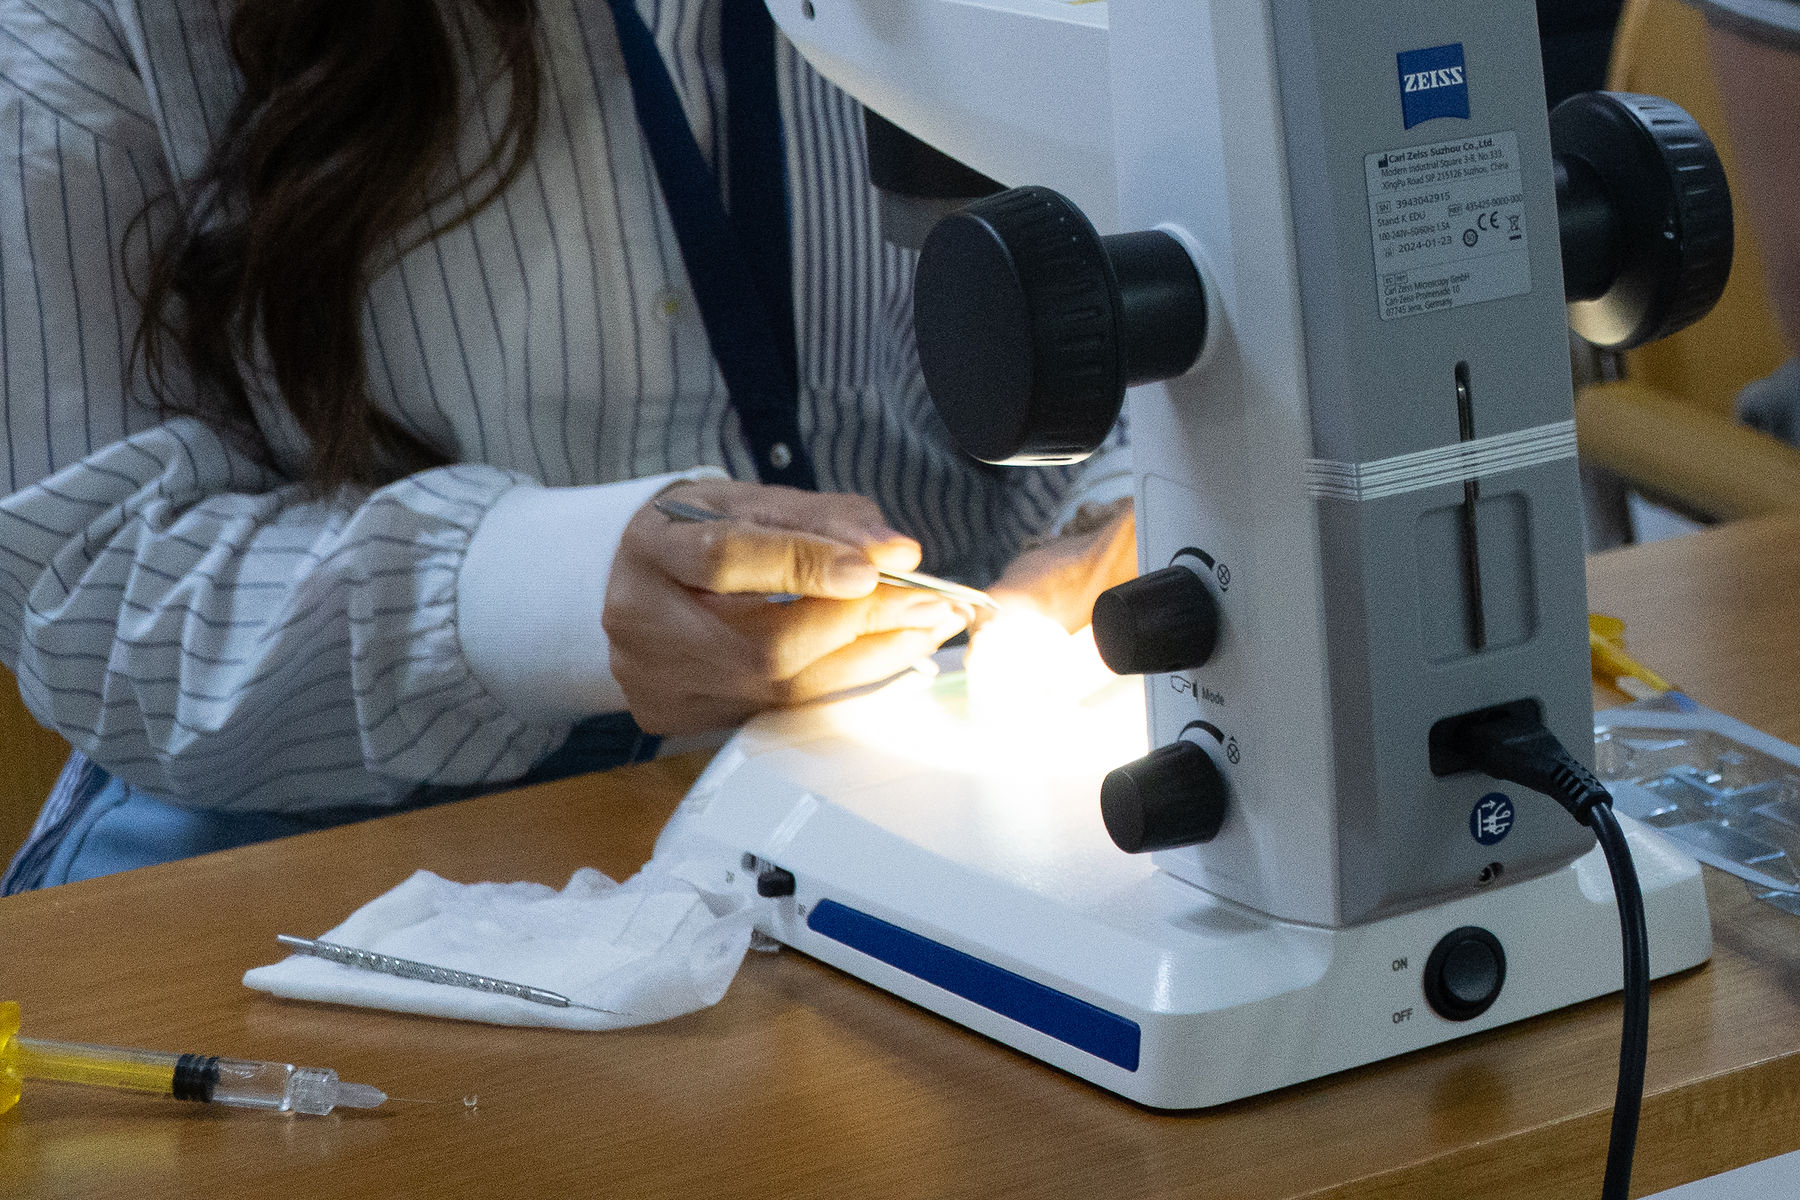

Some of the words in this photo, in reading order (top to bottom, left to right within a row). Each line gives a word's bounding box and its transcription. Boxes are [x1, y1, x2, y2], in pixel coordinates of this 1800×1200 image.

[1404, 66, 1464, 93] ZEISS
[1388, 153, 1406, 164] Carl
[1407, 150, 1428, 161] Zeiss
[1430, 145, 1461, 157] Suzhou
[1409, 211, 1426, 222] EDU
[1398, 236, 1452, 253] 2024-01-23
[1392, 957, 1408, 972] ON
[1392, 1007, 1413, 1024] OFF
